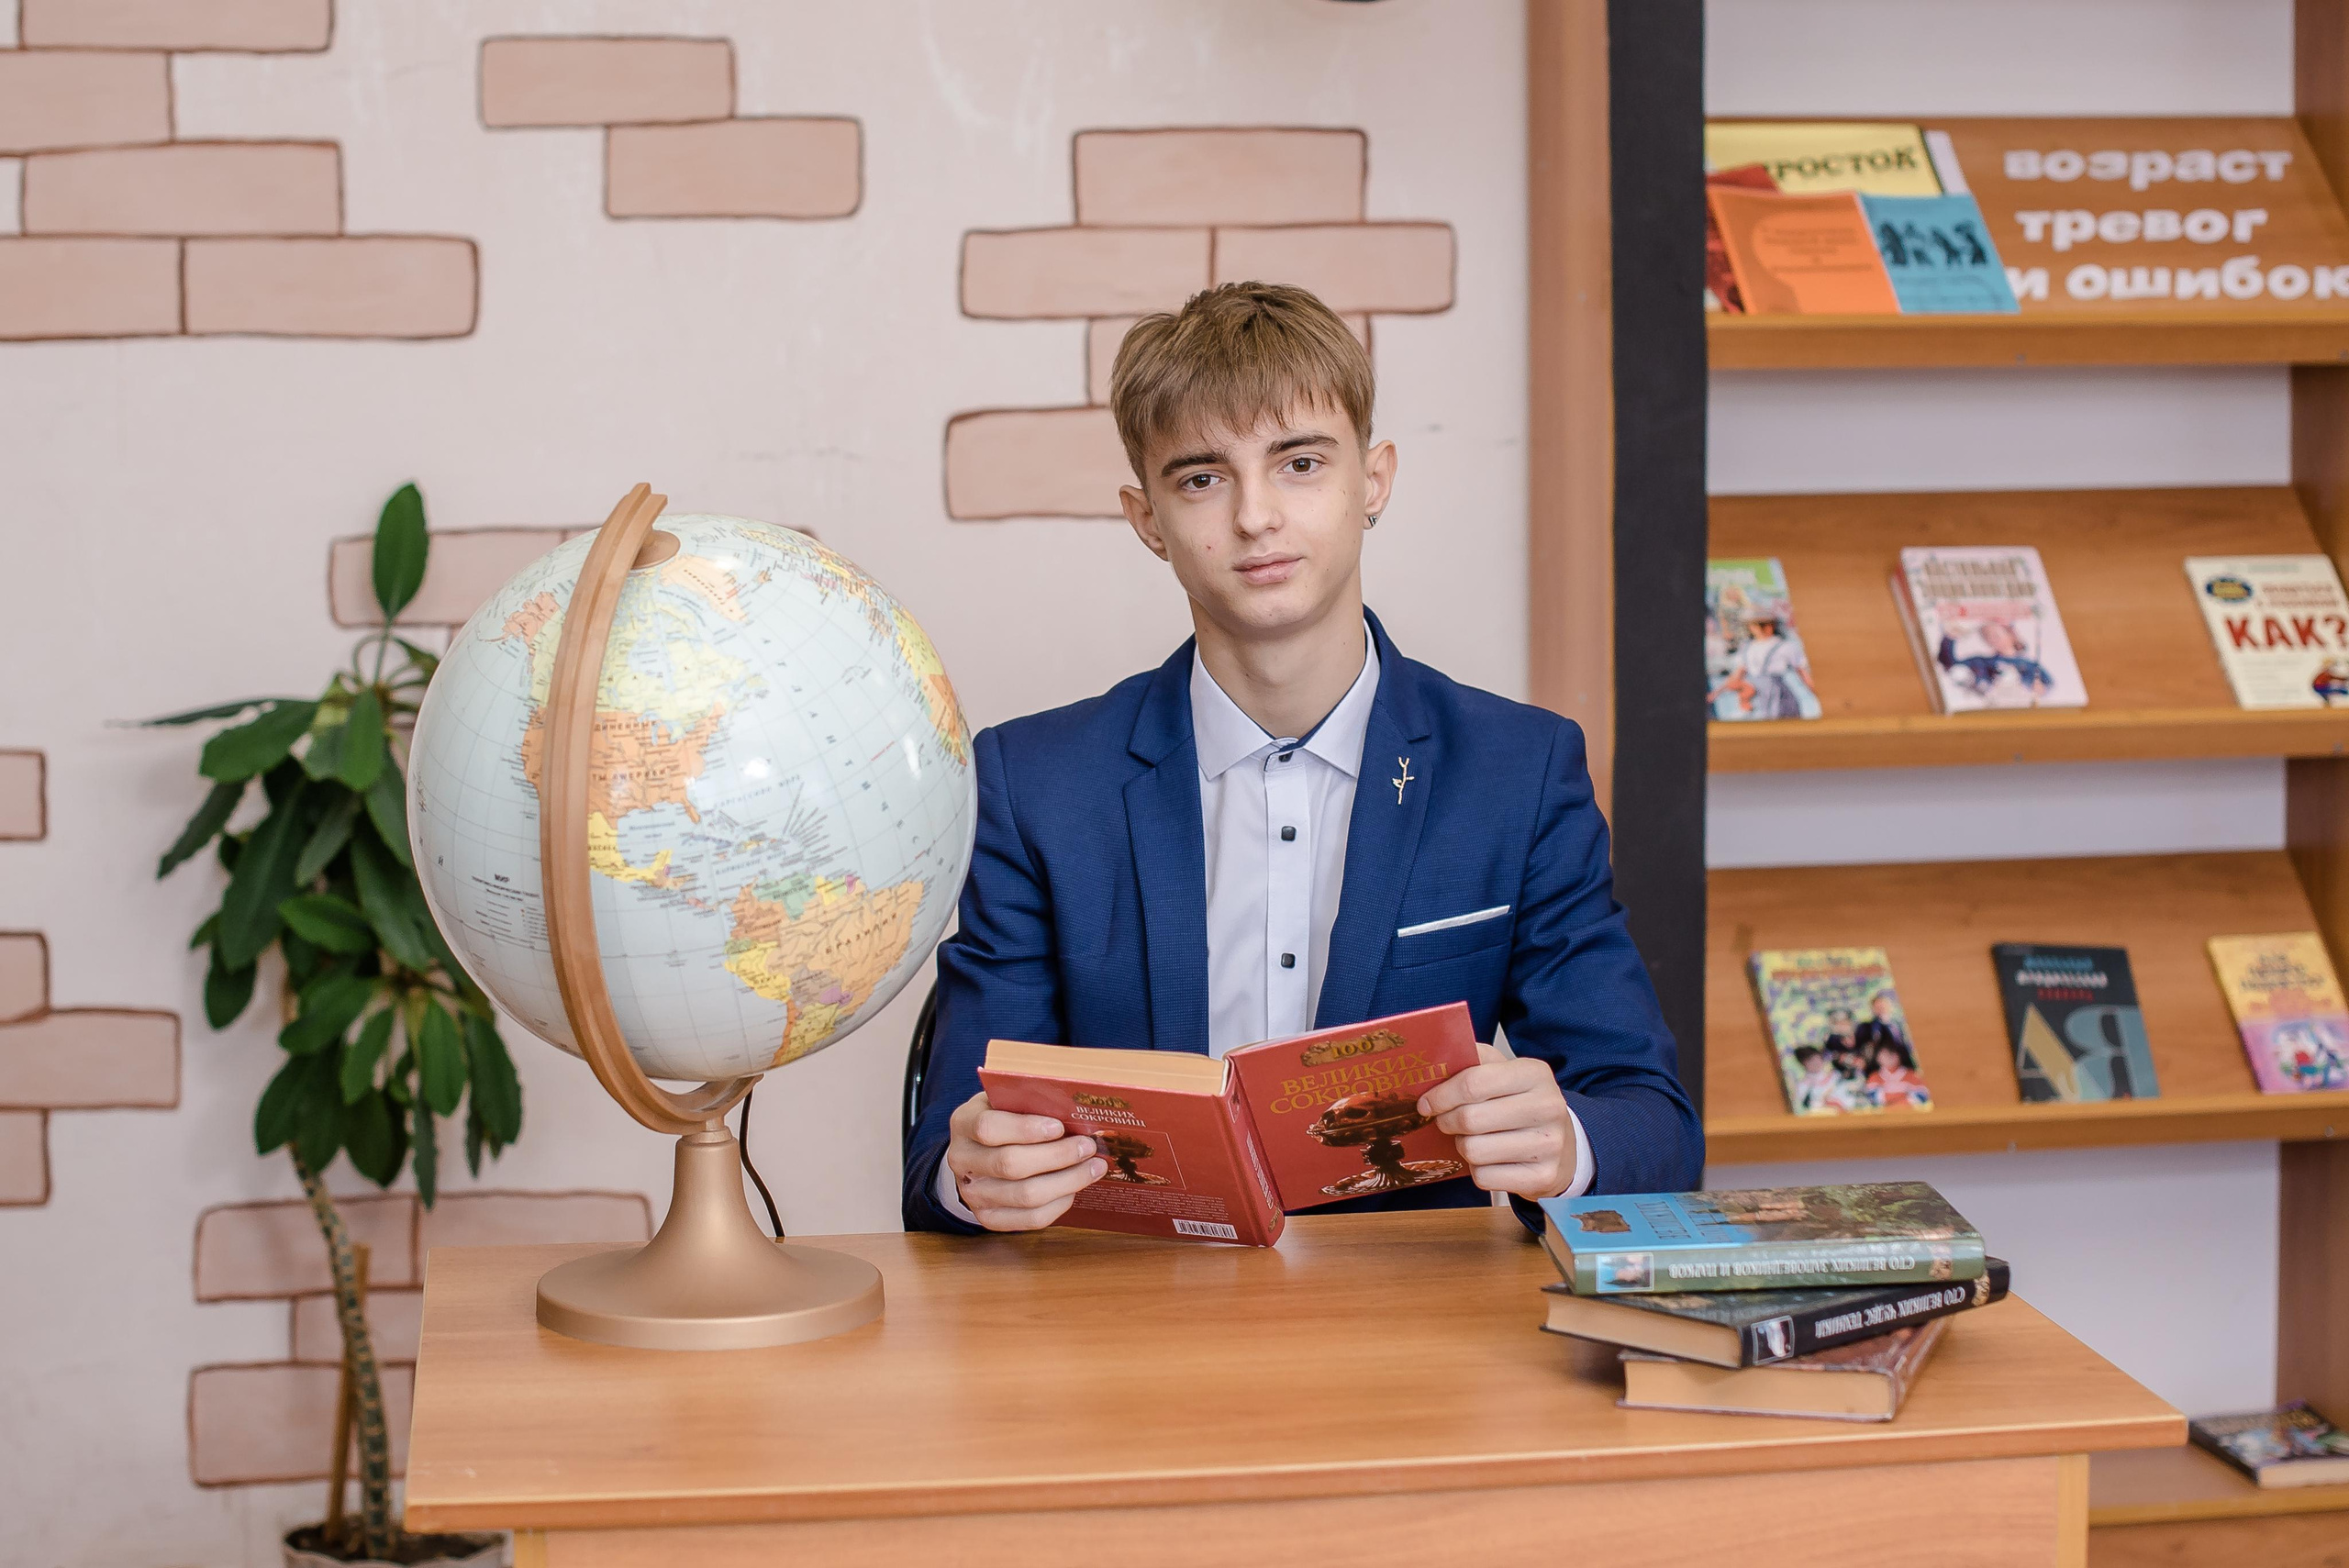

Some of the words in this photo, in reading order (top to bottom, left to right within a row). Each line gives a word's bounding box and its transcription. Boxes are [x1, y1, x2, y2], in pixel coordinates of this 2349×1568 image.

[1765, 146, 1918, 180] РОСТОК
[2003, 149, 2294, 192] возраст
[2013, 208, 2269, 251] тревог
[2005, 266, 2050, 301] и
[2065, 254, 2349, 301] ошибок
[2224, 615, 2348, 651] КАК?
[1332, 1038, 1375, 1060] 100
[1280, 1050, 1431, 1096] ВЕЛИКИХ
[1269, 1062, 1452, 1115] СОКРОВИЩ
[1070, 1112, 1147, 1129] СОКРОВИЩ
[1074, 1105, 1137, 1119] ВЕЛИКИХ
[1668, 1262, 1718, 1279] ПАРКОВ
[1719, 1262, 1731, 1277] И
[1731, 1258, 1829, 1276] ЗАПОВЕДНИКОВ
[1831, 1256, 1887, 1273] ВЕЛИКИХ
[1887, 1254, 1916, 1271] СТО
[1897, 1291, 1943, 1318] ВЕЛИКИХ
[1943, 1285, 1966, 1307] СТО
[1814, 1310, 1865, 1340] ТЕХНИКИ
[1863, 1302, 1898, 1328] ЧУДЕС
